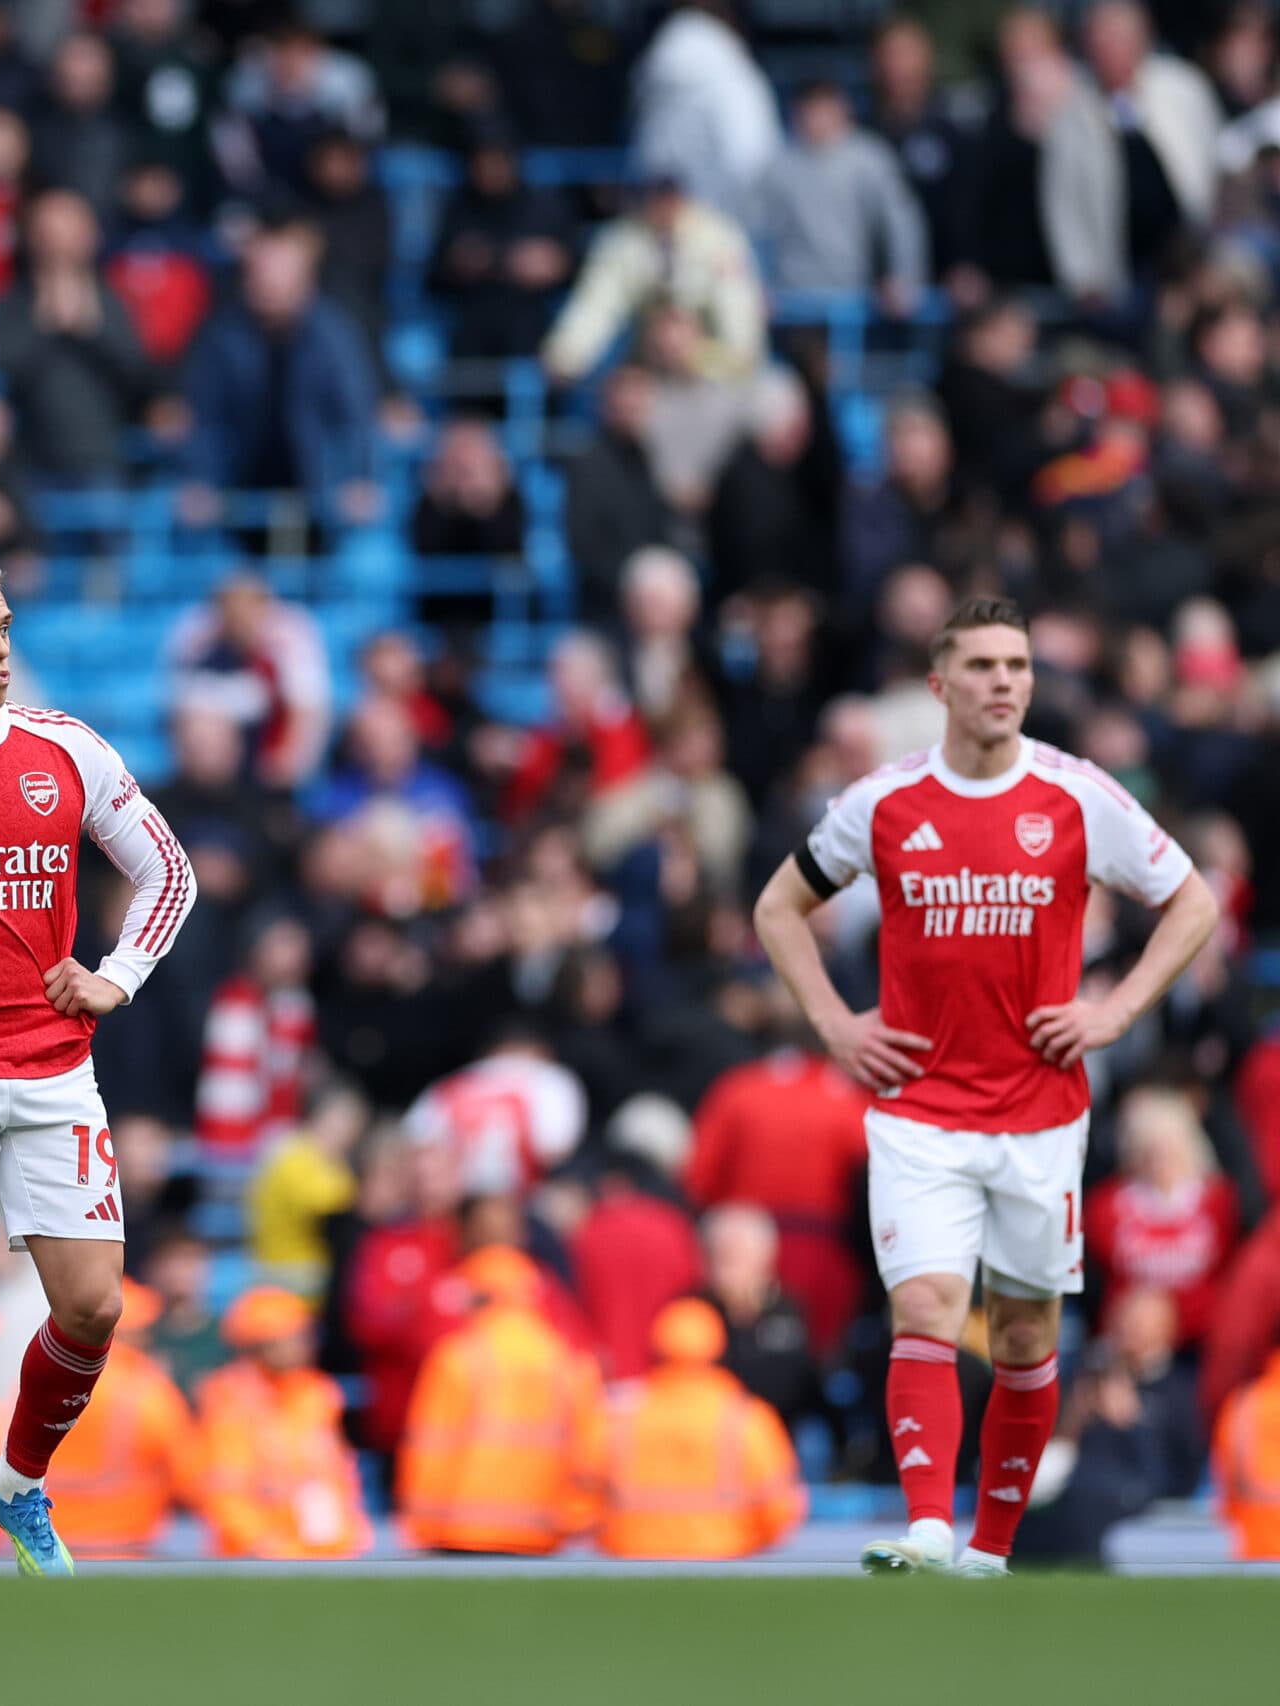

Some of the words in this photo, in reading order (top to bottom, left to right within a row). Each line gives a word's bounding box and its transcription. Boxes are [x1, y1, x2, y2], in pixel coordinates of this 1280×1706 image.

[900, 866, 1056, 907] Emirates
[923, 907, 959, 938] FLY
[961, 906, 1035, 938] BETTER
[72, 1125, 116, 1188] 19
